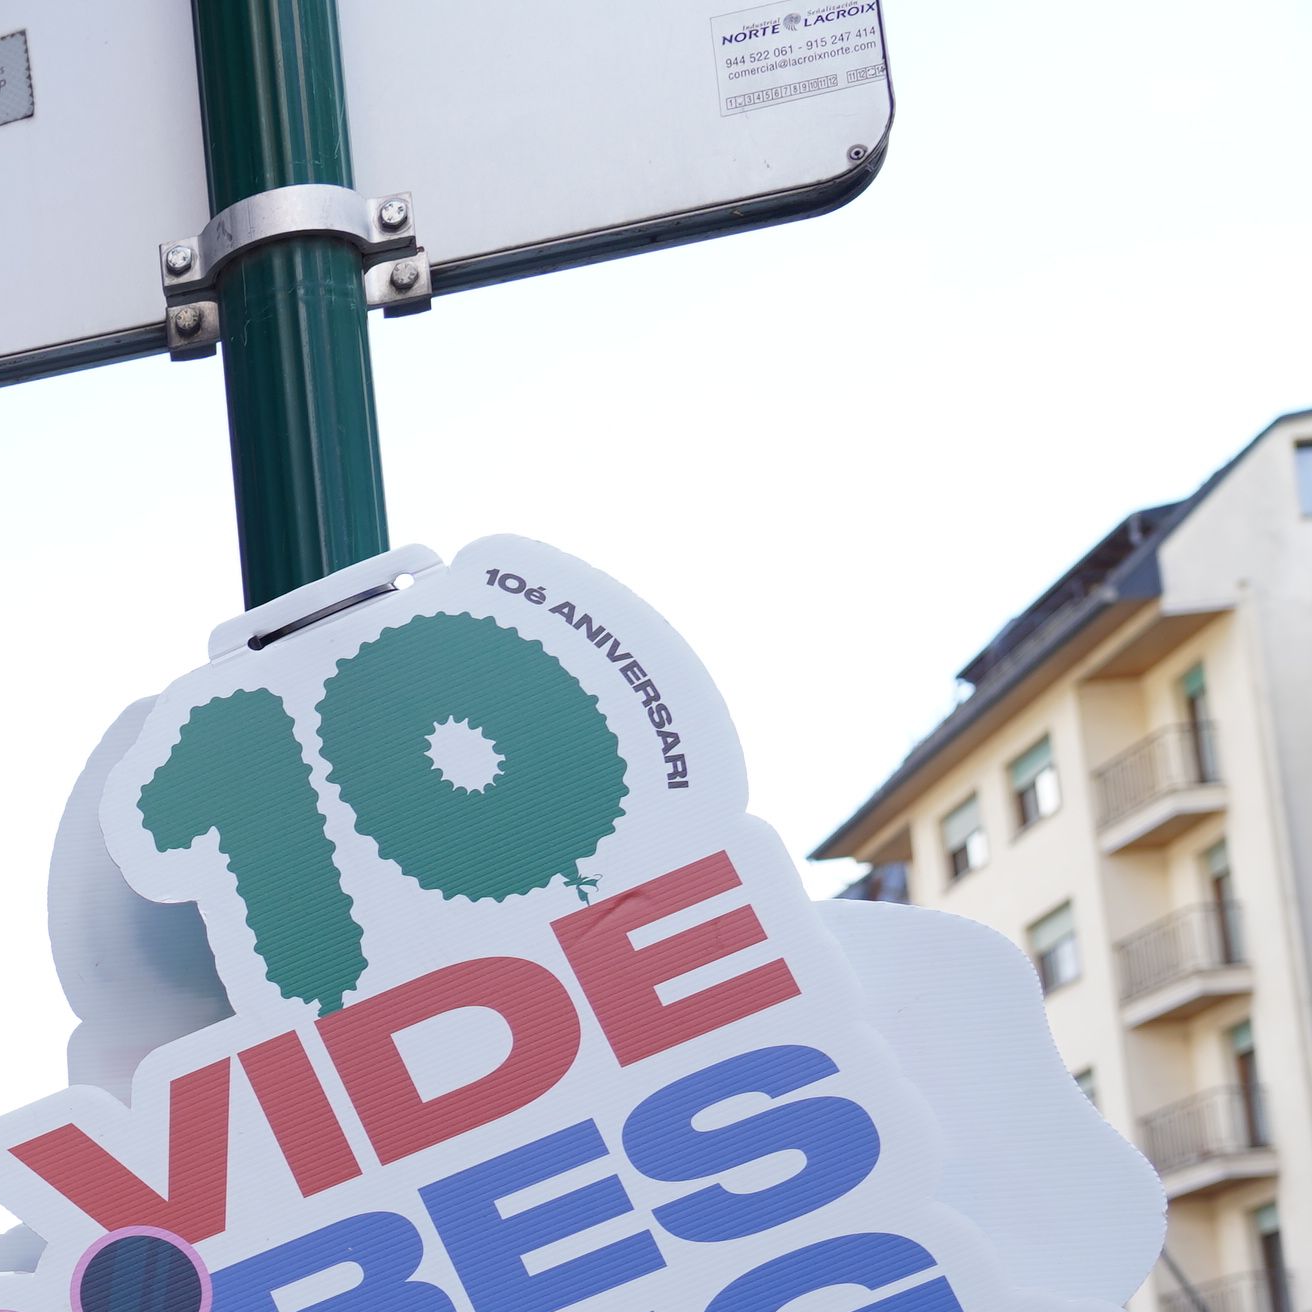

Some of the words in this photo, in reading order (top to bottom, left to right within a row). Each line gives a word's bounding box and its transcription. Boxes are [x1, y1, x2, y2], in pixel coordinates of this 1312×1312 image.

[722, 23, 780, 45] NORTE
[804, 2, 876, 27] LACROIX
[742, 17, 781, 31] Industrial
[725, 55, 746, 68] 944
[749, 50, 770, 63] 522
[773, 45, 793, 58] 061
[806, 36, 827, 51] 915
[830, 31, 851, 45] 247
[856, 26, 876, 39] 414
[728, 40, 877, 80] comercial@lacroixnorte.com
[485, 568, 547, 605] 10é
[548, 601, 689, 789] ANIVERSARI
[137, 611, 629, 1017] 10
[8, 850, 802, 1246] VIDE
